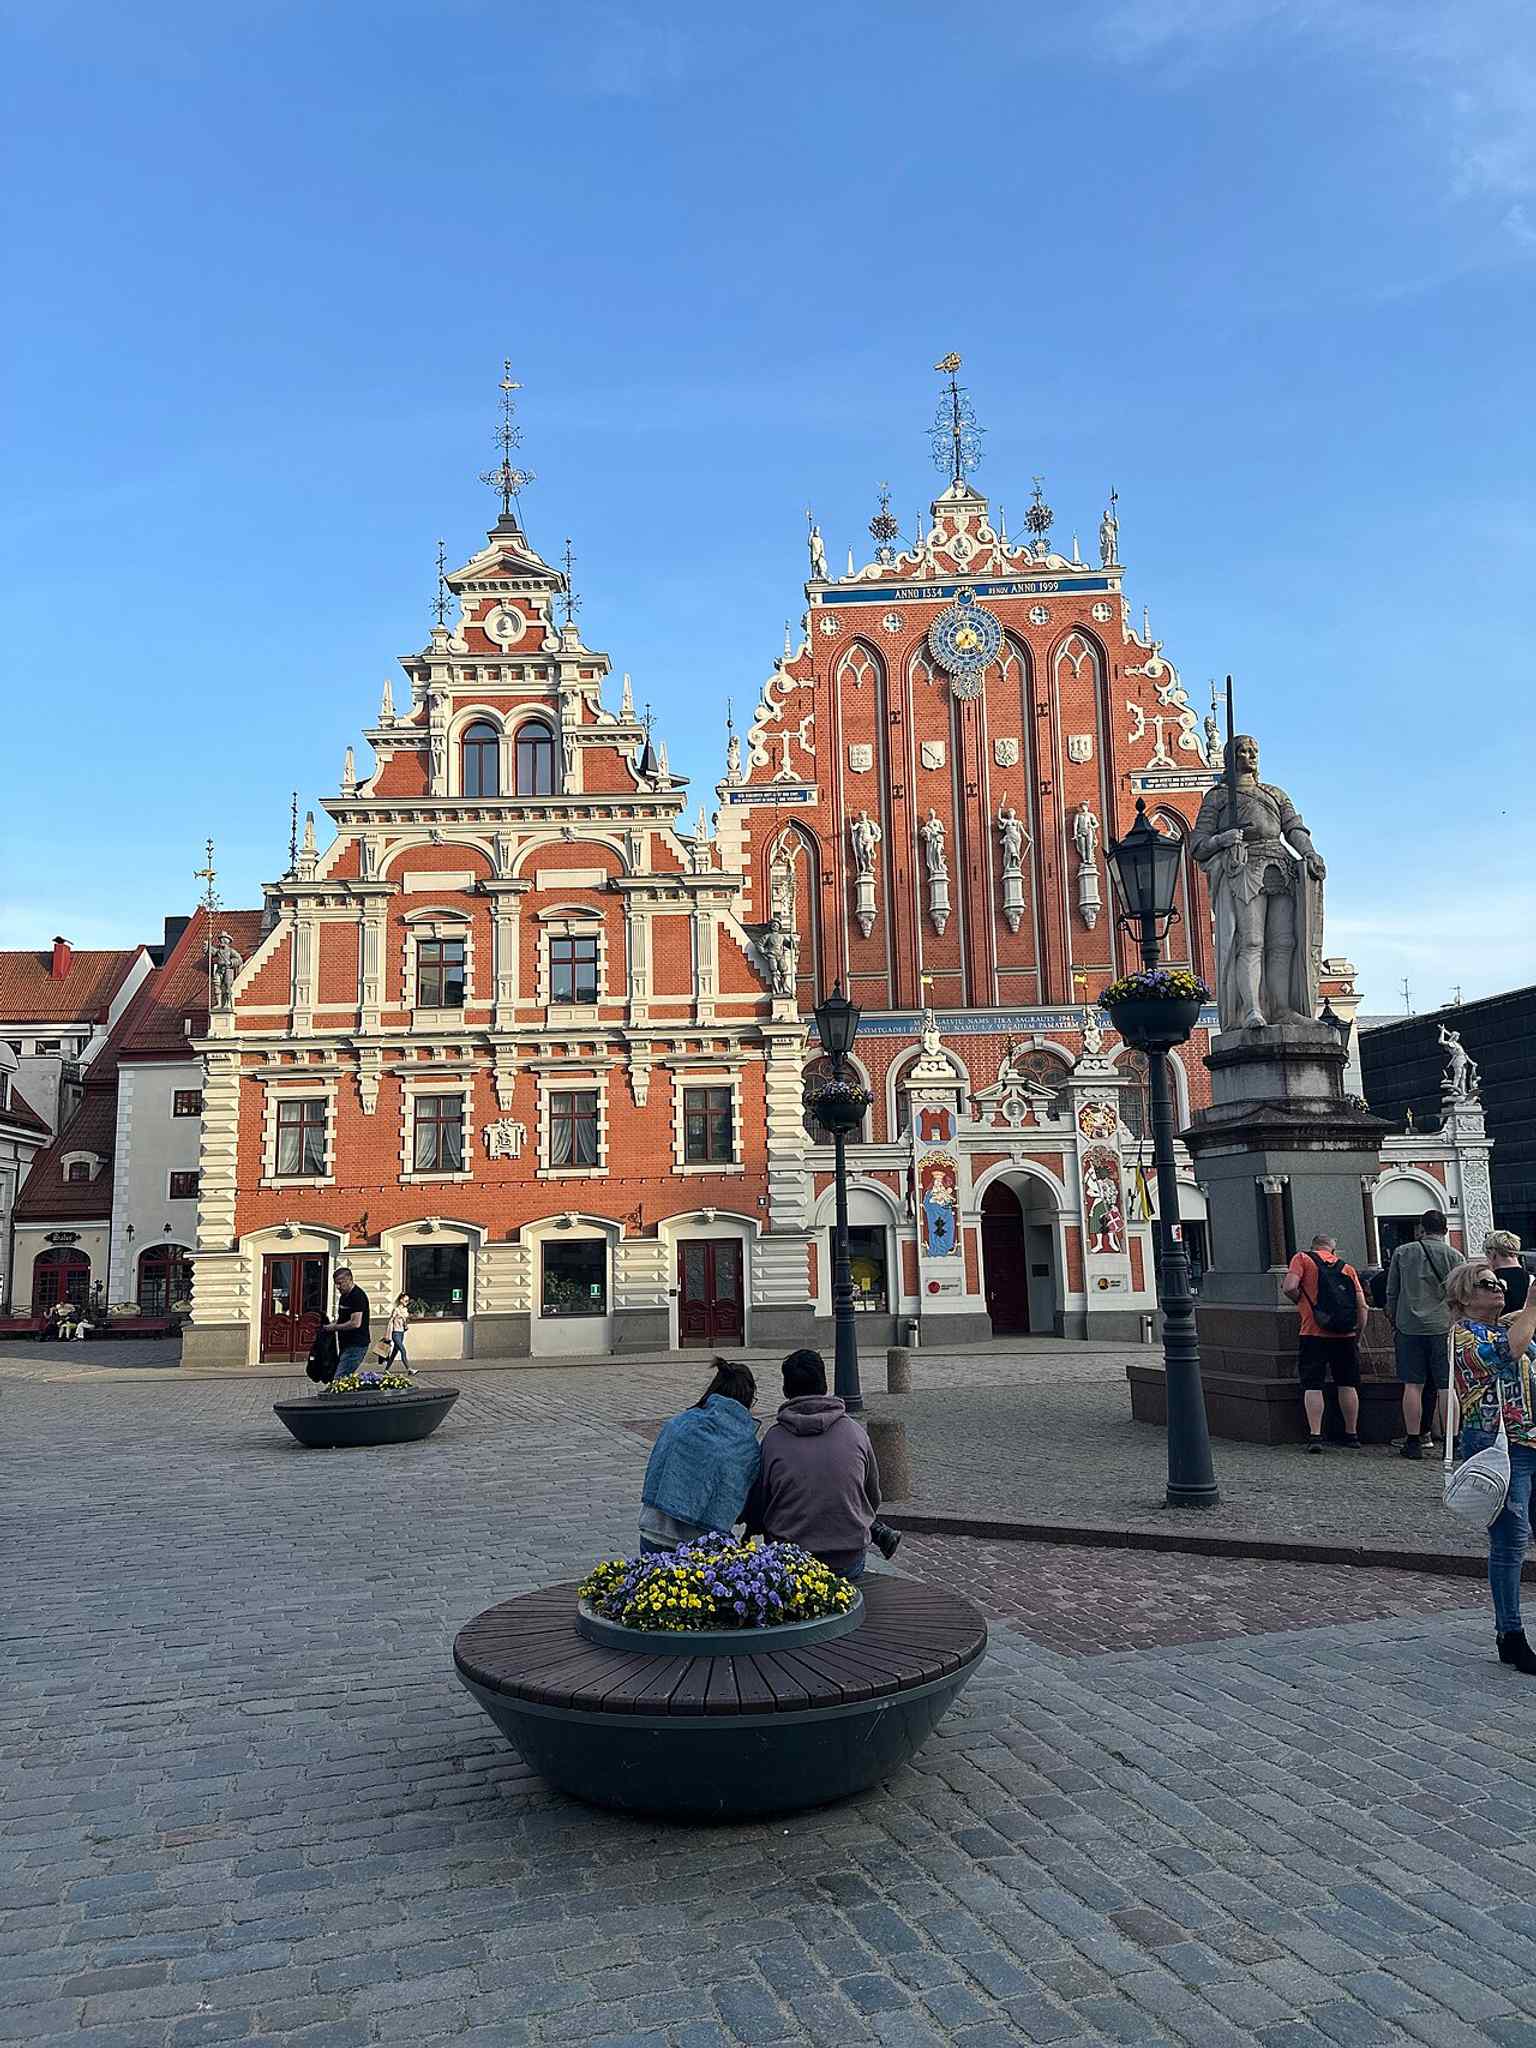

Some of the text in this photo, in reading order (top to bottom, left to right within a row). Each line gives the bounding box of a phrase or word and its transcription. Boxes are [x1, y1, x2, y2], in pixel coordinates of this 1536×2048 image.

[1011, 582, 1036, 593] ANNO
[1040, 580, 1059, 592] 1999
[895, 588, 919, 599] ANNO
